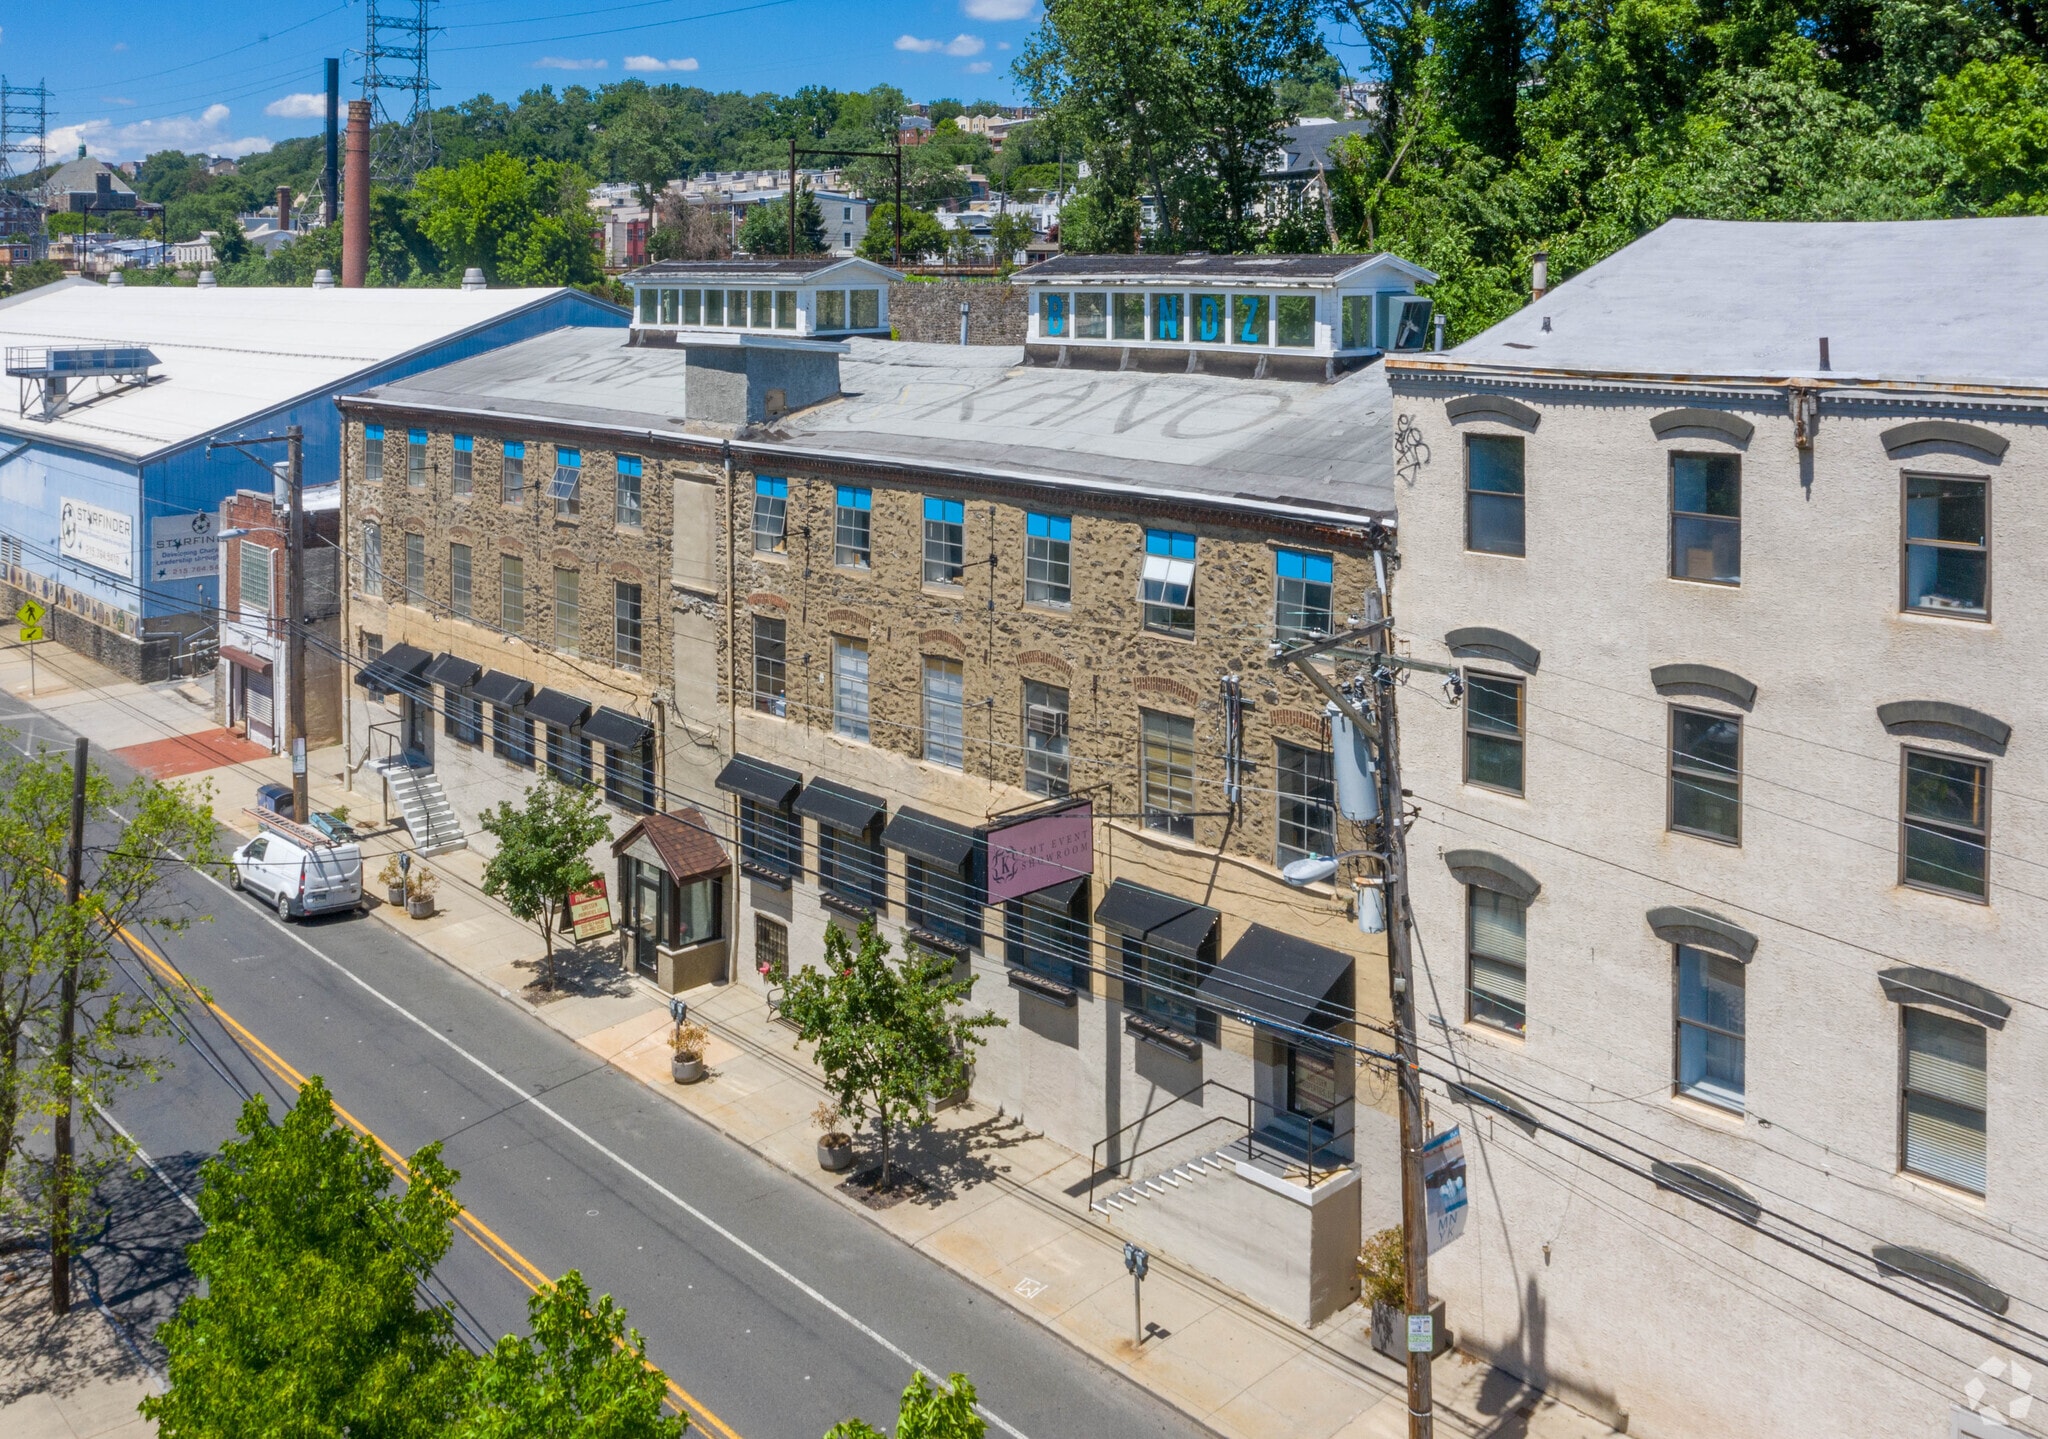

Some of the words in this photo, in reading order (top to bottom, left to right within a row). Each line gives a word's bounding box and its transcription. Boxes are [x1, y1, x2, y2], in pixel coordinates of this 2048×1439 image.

[156, 535, 219, 550] STARFIN
[1051, 830, 1088, 849] EVENT
[1021, 842, 1088, 871] SHOWROOM
[1438, 1212, 1458, 1231] MN
[1438, 1226, 1455, 1243] YK
